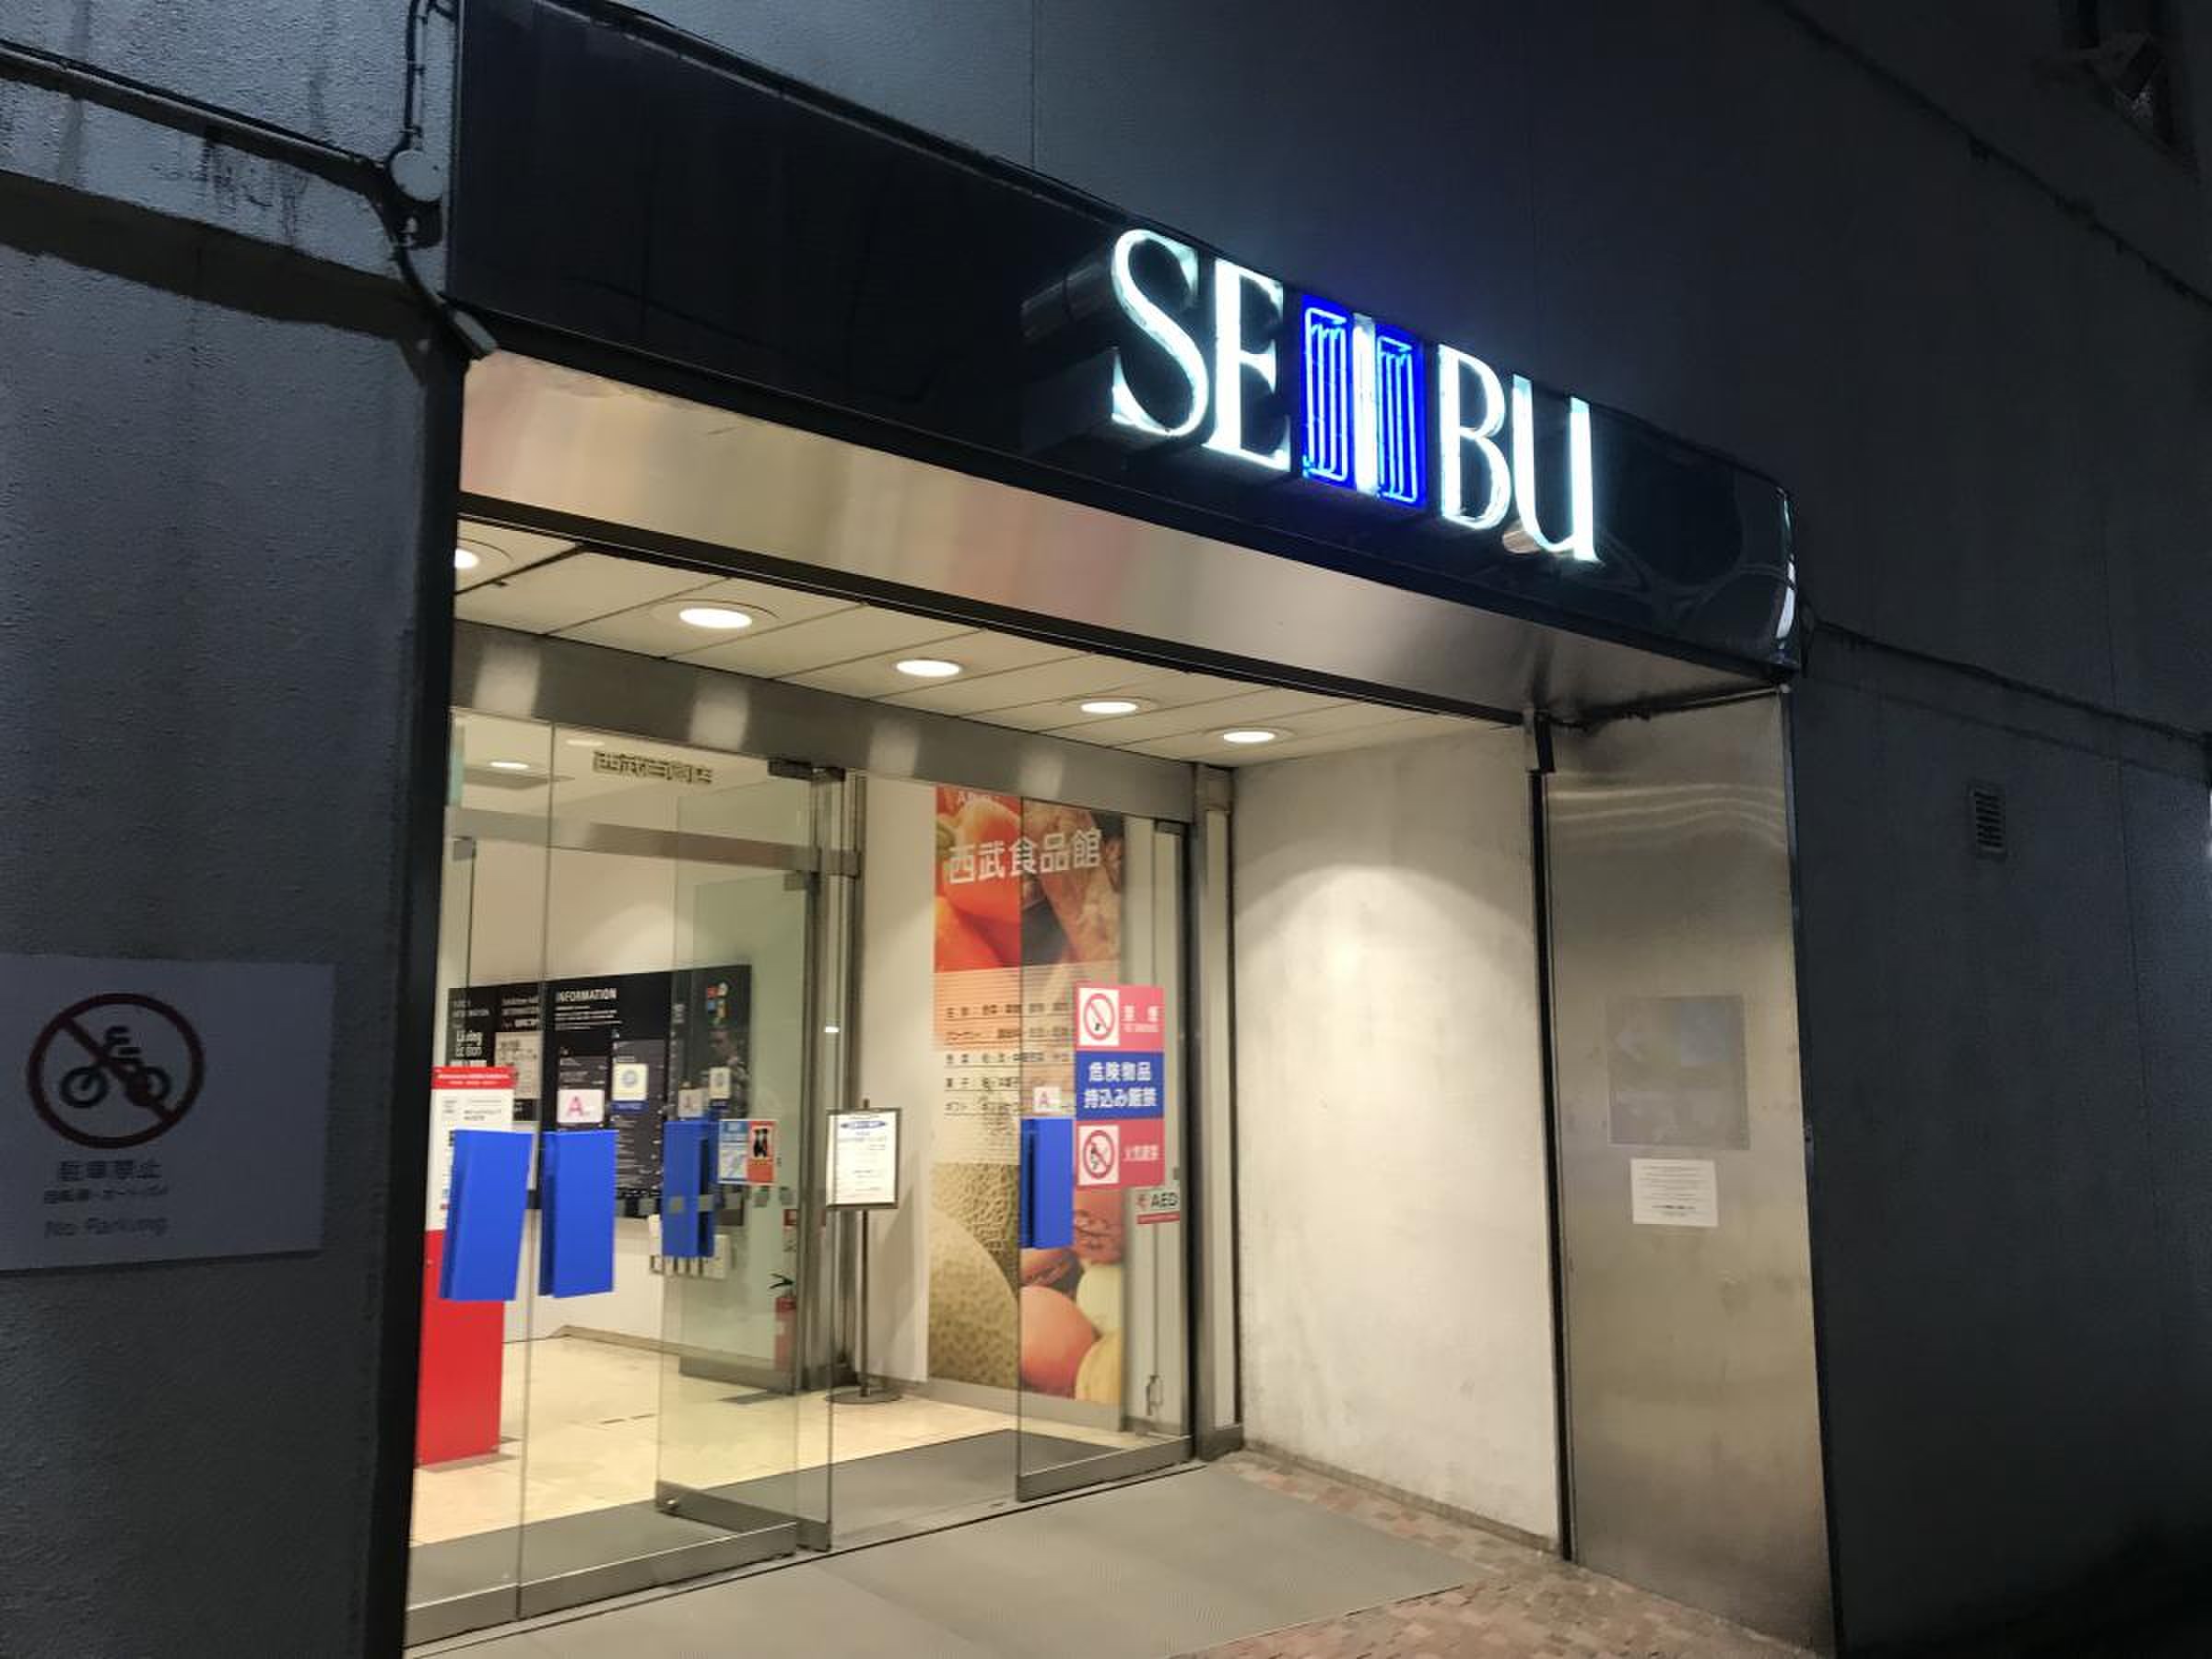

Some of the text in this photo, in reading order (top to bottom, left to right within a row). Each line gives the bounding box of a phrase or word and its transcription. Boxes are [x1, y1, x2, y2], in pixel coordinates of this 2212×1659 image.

[1111, 229, 1602, 562] SEIBU
[948, 828, 1103, 885] 西武食品館
[555, 987, 618, 1003] INFORMATION
[1151, 1192, 1179, 1207] AED
